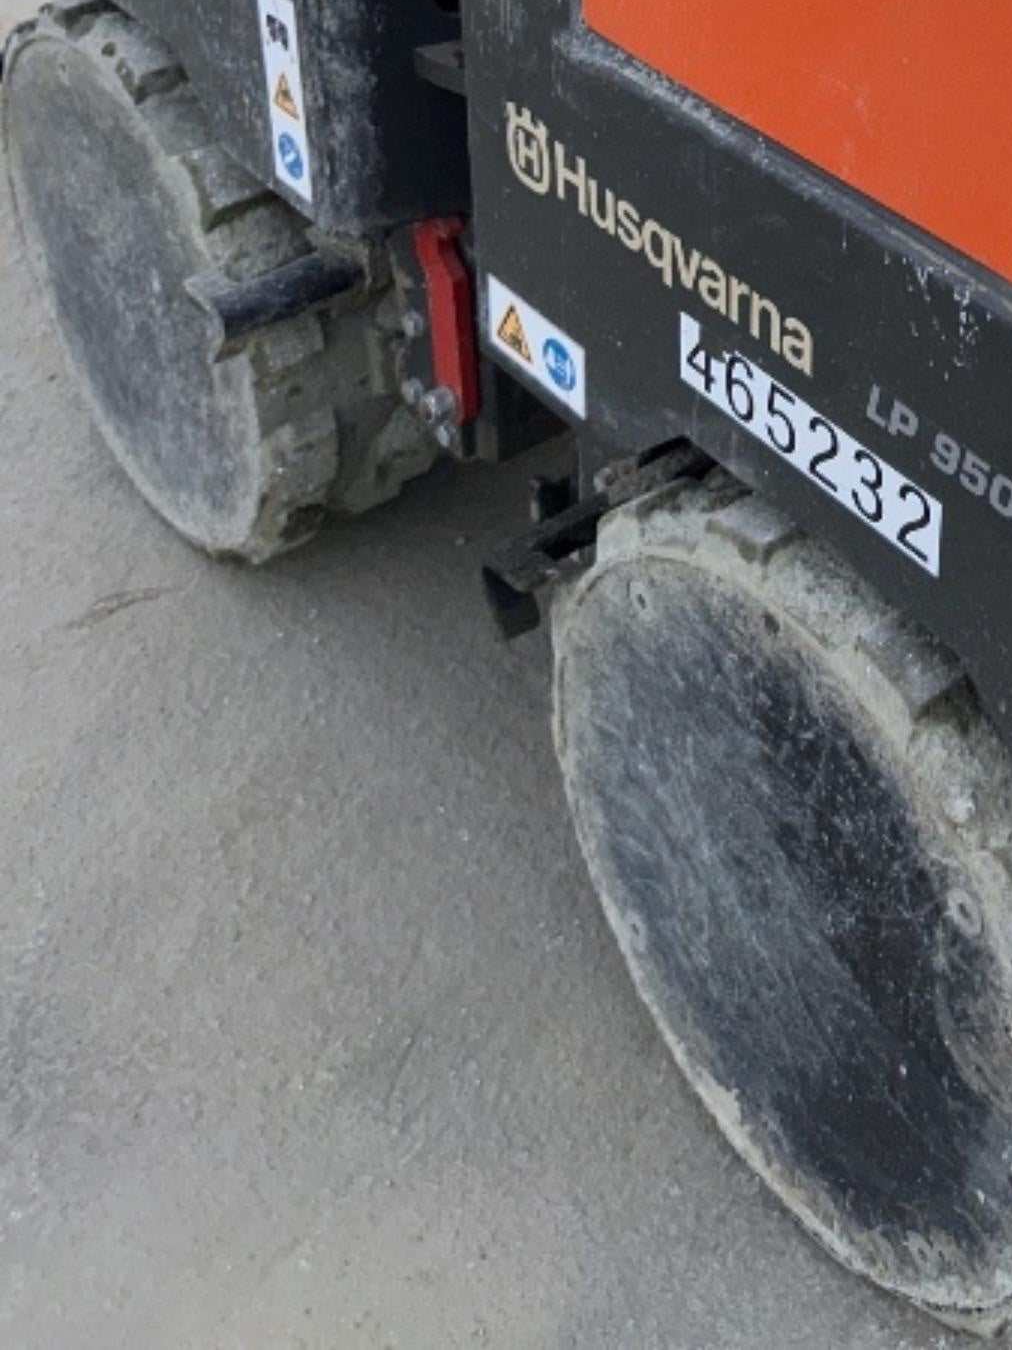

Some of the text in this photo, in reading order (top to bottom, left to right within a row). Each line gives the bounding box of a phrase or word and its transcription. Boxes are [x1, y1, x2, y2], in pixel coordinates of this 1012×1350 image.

[554, 141, 814, 378] Husqvarna
[687, 350, 931, 562] 465232
[866, 383, 918, 439] LP
